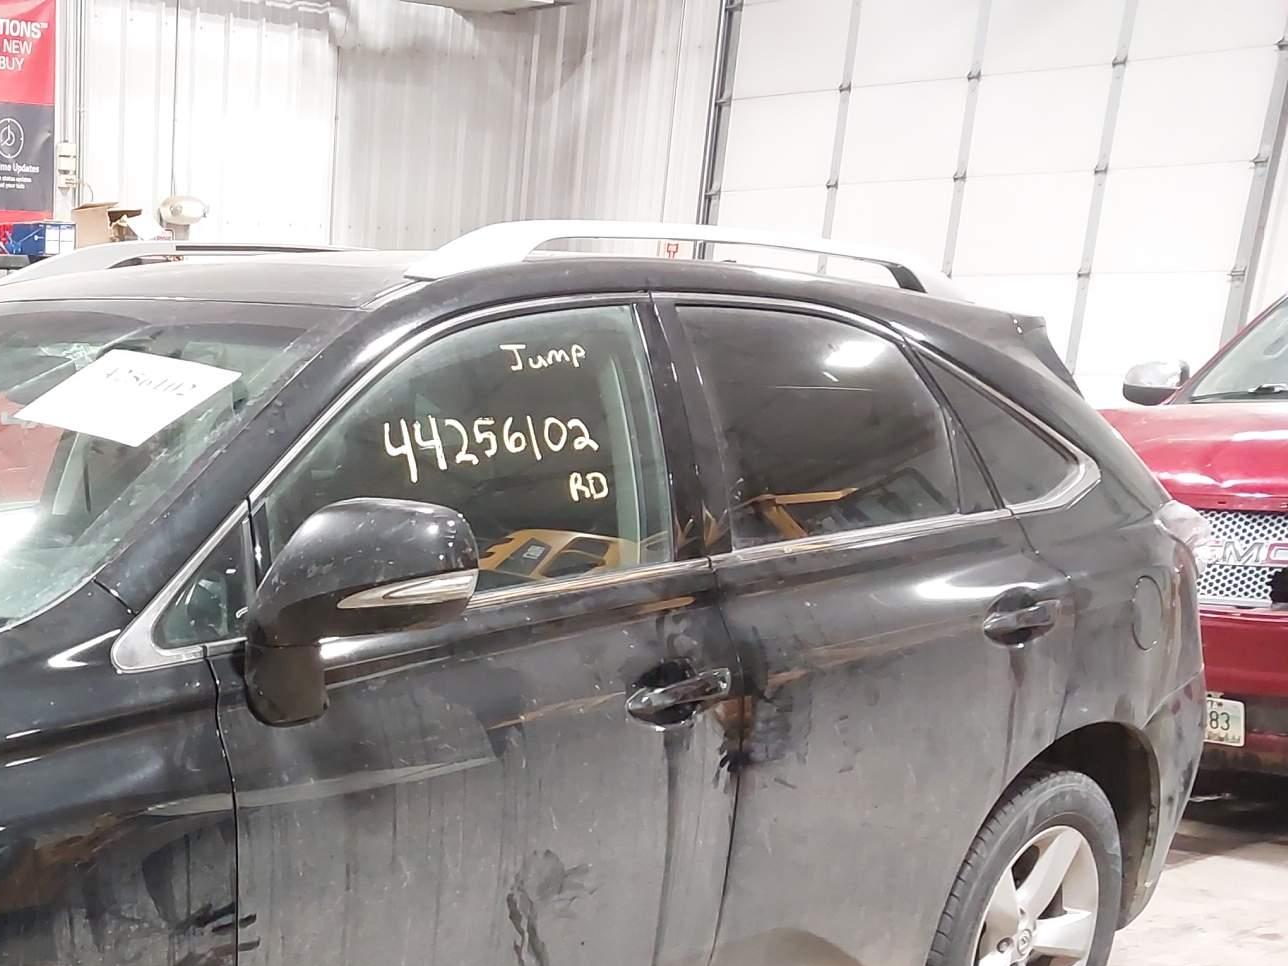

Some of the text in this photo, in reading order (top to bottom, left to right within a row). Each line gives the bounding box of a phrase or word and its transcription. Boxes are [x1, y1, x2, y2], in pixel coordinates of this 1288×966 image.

[3, 38, 32, 55] NEW
[13, 162, 40, 174] Updates
[499, 343, 587, 371] Jump
[383, 414, 599, 483] 44256102
[569, 471, 609, 501] RD
[1209, 710, 1231, 731] 83
